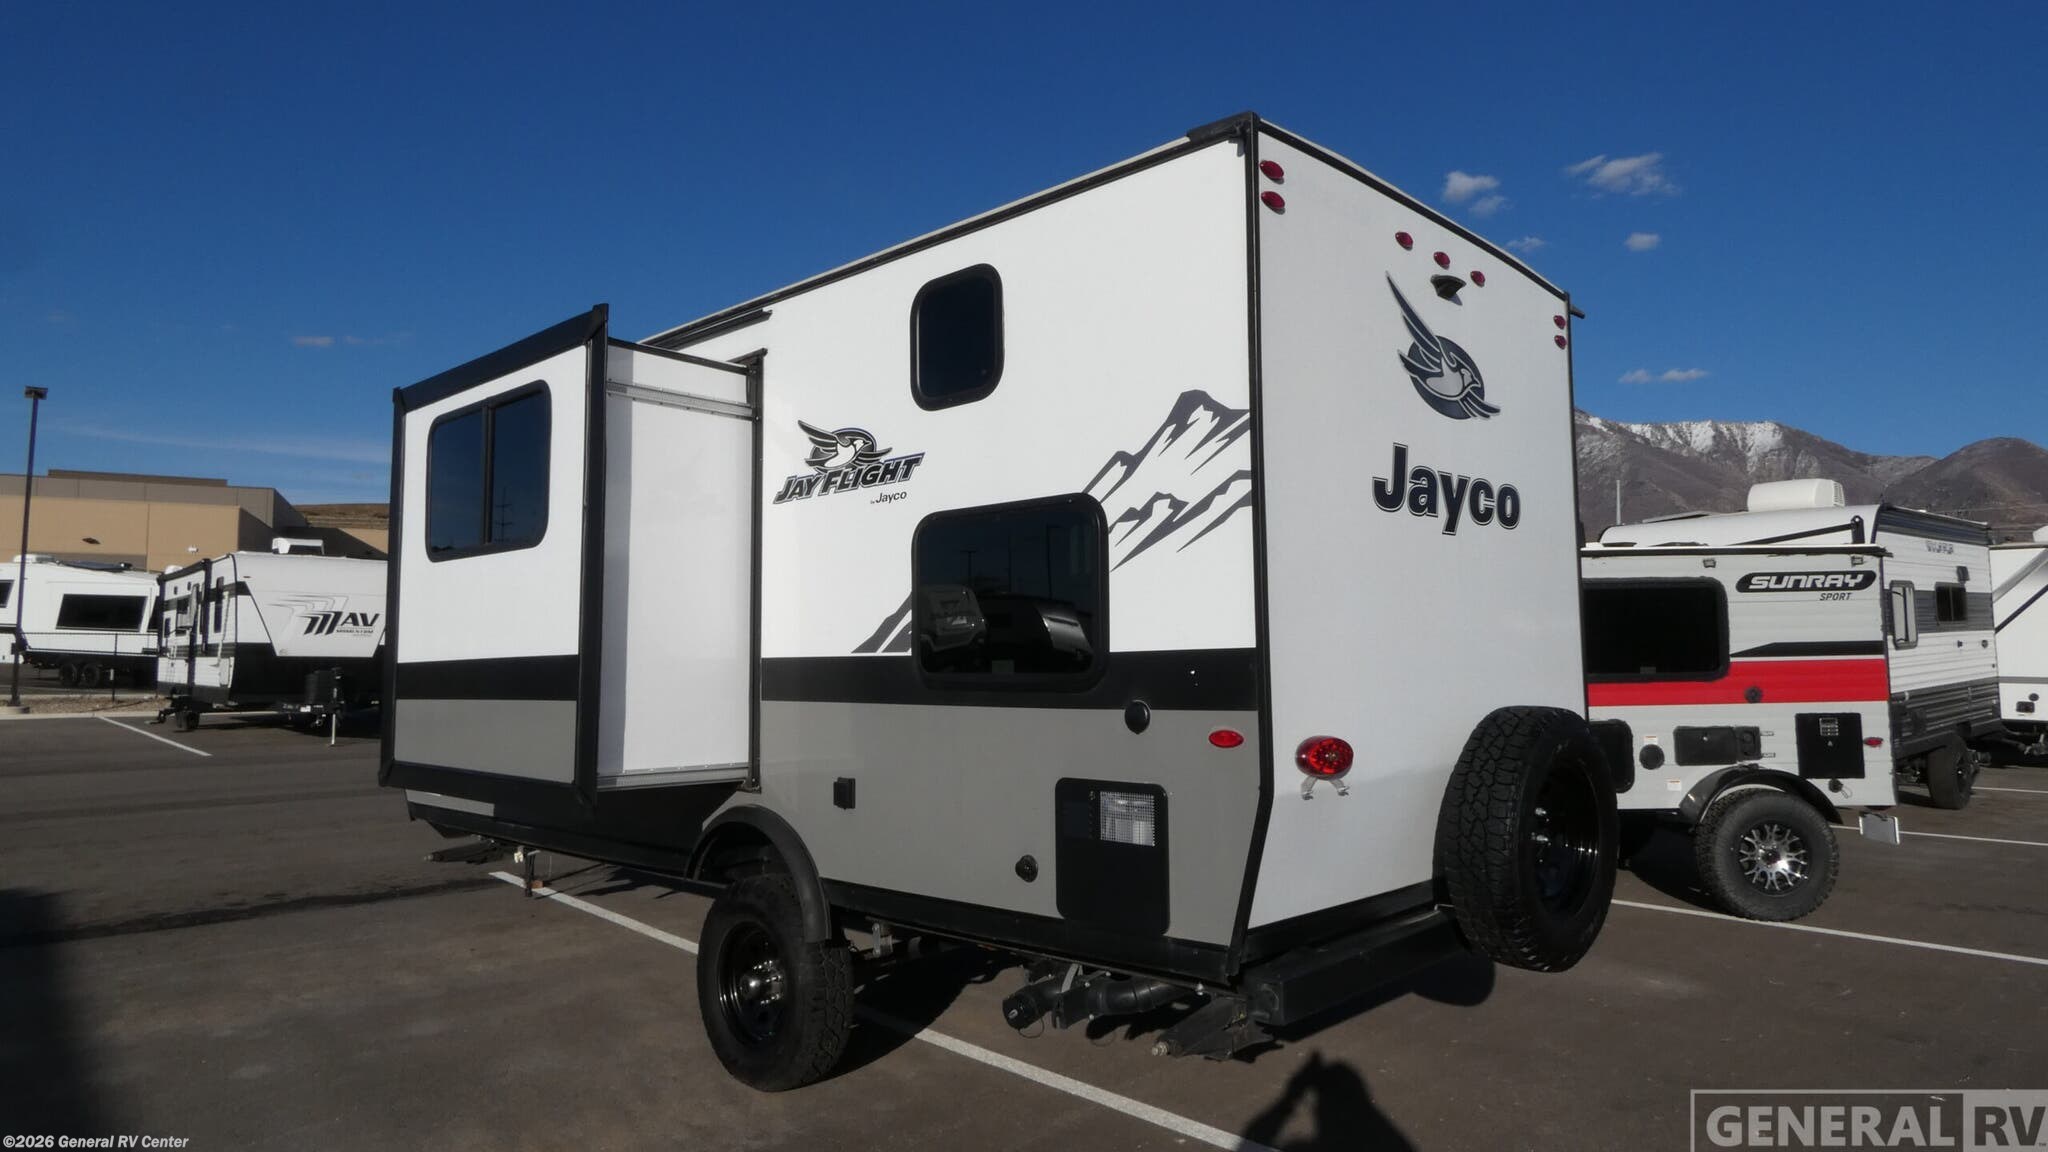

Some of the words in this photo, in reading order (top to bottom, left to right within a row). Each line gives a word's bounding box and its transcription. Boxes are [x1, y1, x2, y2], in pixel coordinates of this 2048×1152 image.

[1372, 442, 1521, 536] Jayco
[875, 491, 907, 504] Jayco
[1749, 574, 1864, 589] SUNRAY
[1819, 592, 1852, 601] SPORT
